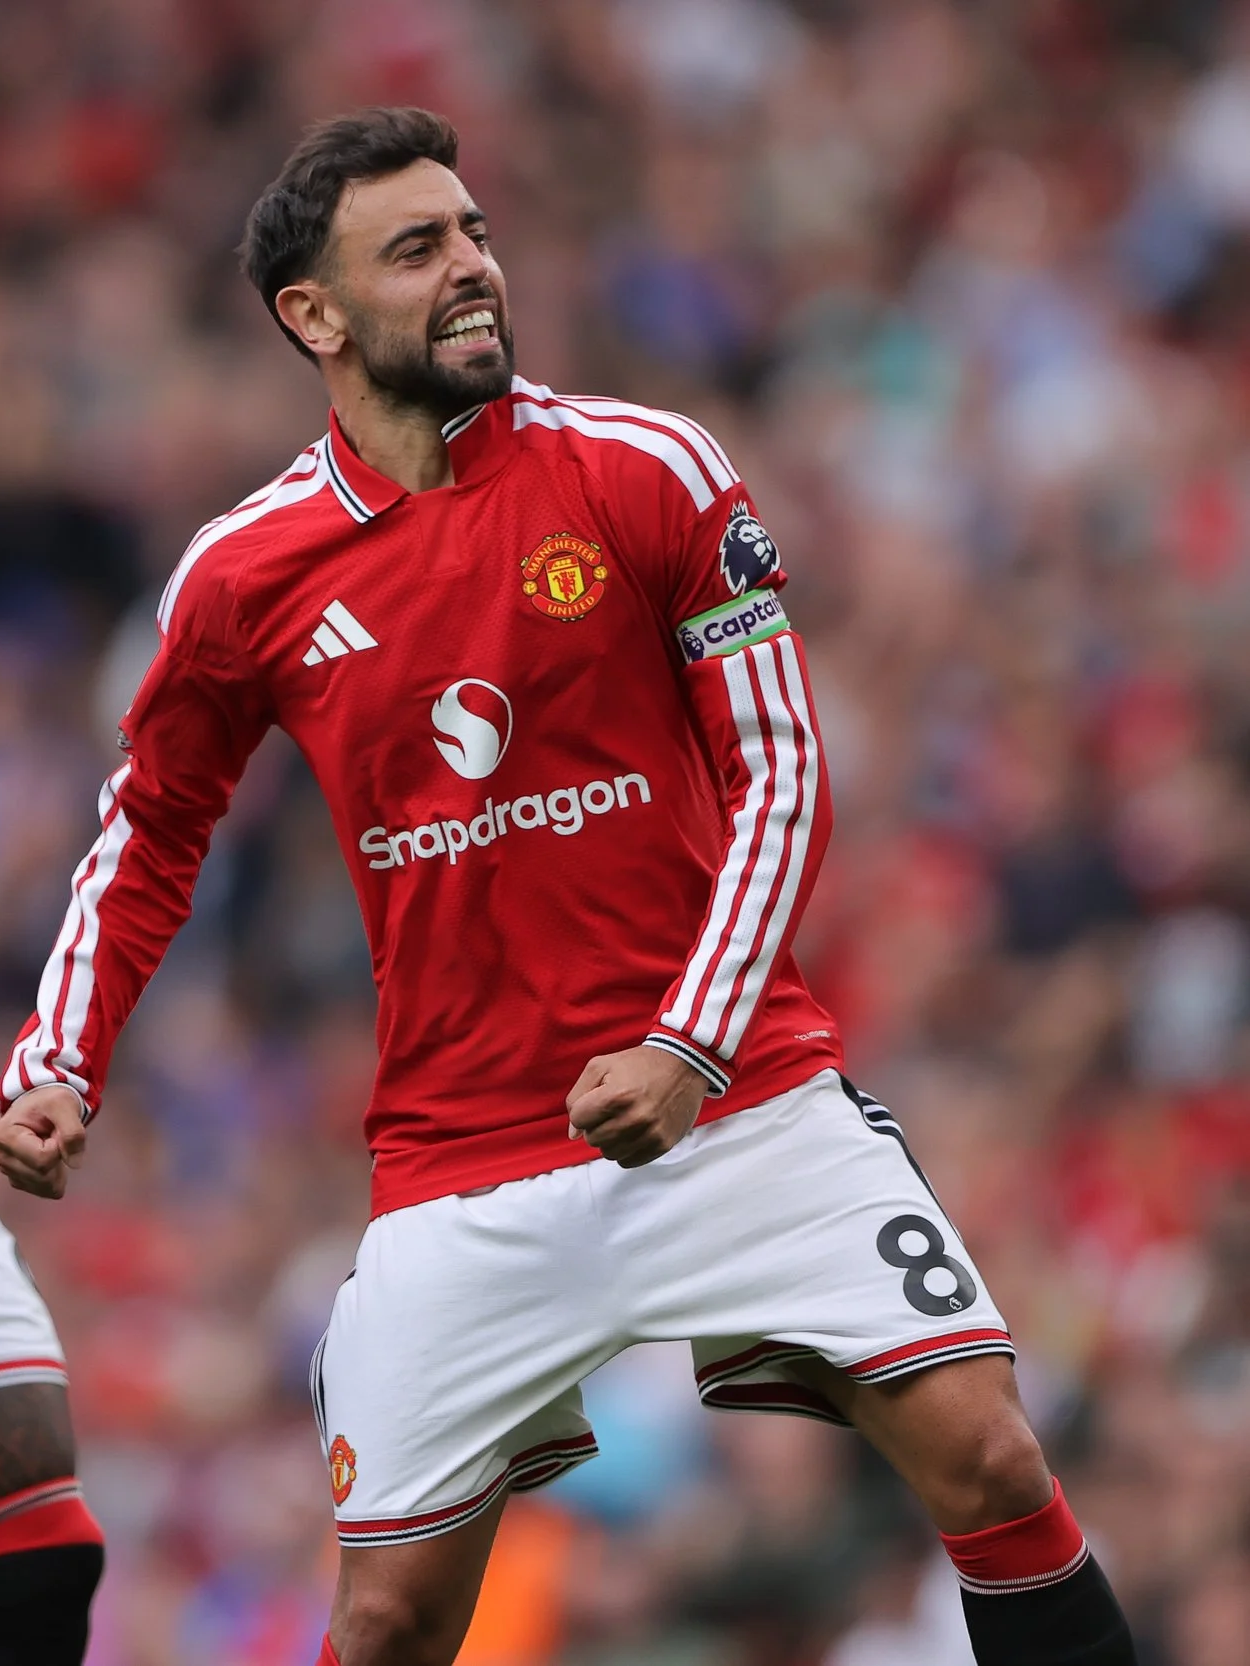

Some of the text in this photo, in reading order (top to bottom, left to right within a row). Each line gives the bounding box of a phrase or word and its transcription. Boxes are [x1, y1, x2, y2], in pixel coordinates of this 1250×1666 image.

[528, 540, 596, 574] MANCHESTER
[547, 596, 595, 615] UNITED
[358, 773, 652, 870] Snapdragon
[876, 1214, 977, 1316] 8
